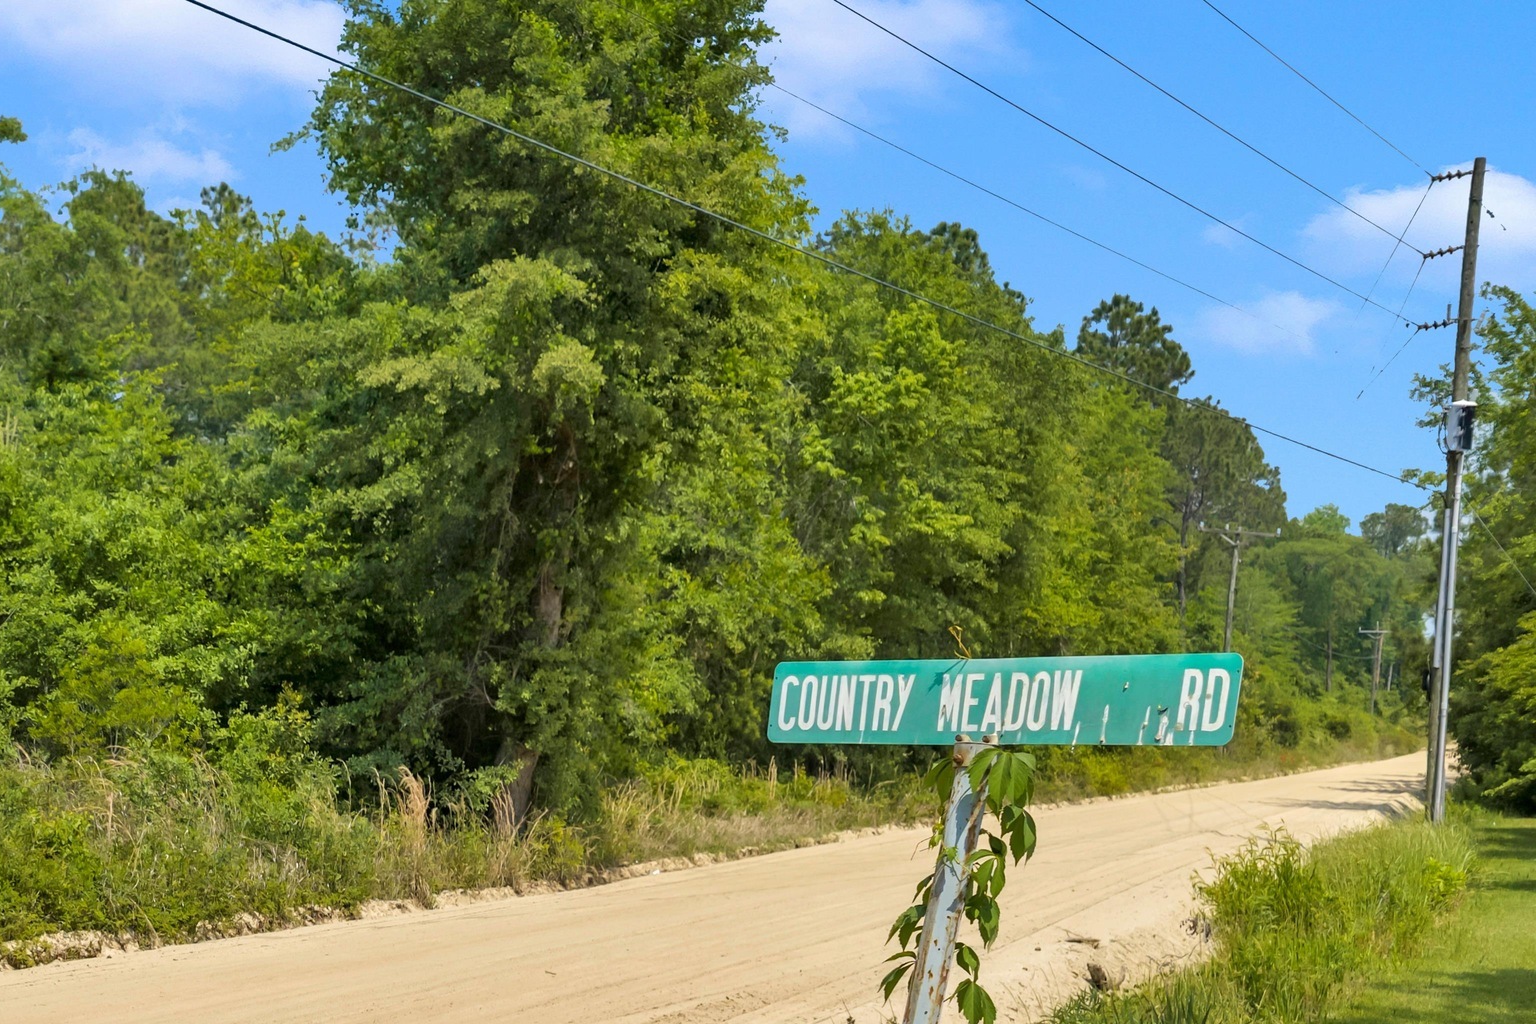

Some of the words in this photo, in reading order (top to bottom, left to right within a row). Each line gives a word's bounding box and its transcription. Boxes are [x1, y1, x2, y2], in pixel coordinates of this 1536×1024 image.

[777, 674, 915, 732] COUNTRY
[937, 669, 1083, 732] MEADOW
[1177, 668, 1231, 732] RD
